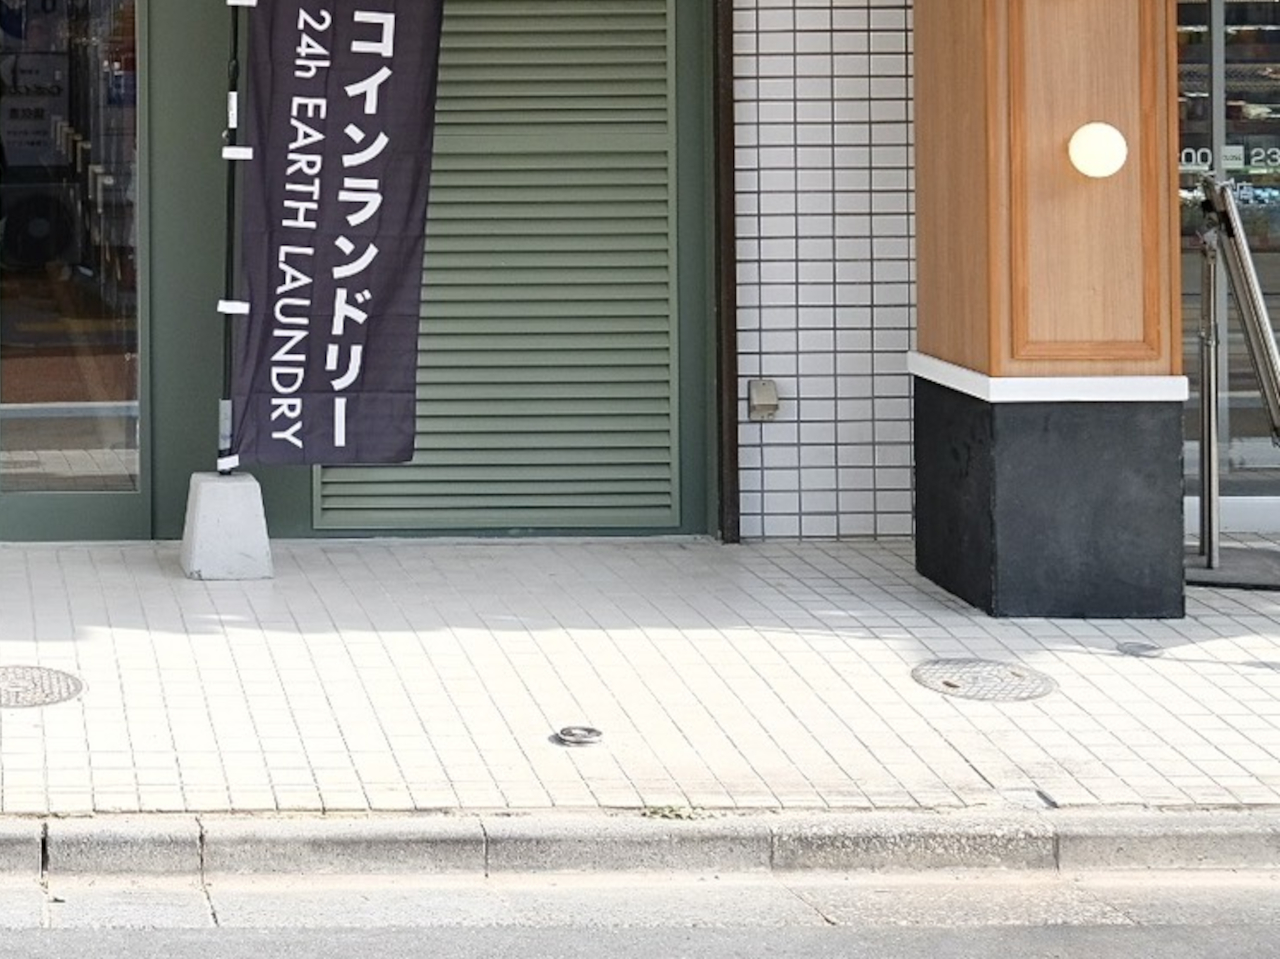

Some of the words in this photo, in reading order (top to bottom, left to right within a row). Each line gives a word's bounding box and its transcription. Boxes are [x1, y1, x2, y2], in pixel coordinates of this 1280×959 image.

[294, 8, 332, 78] 24h
[281, 96, 327, 229] EARTH
[325, 11, 396, 447] コインランドリー
[269, 246, 315, 449] LAUNDRY
